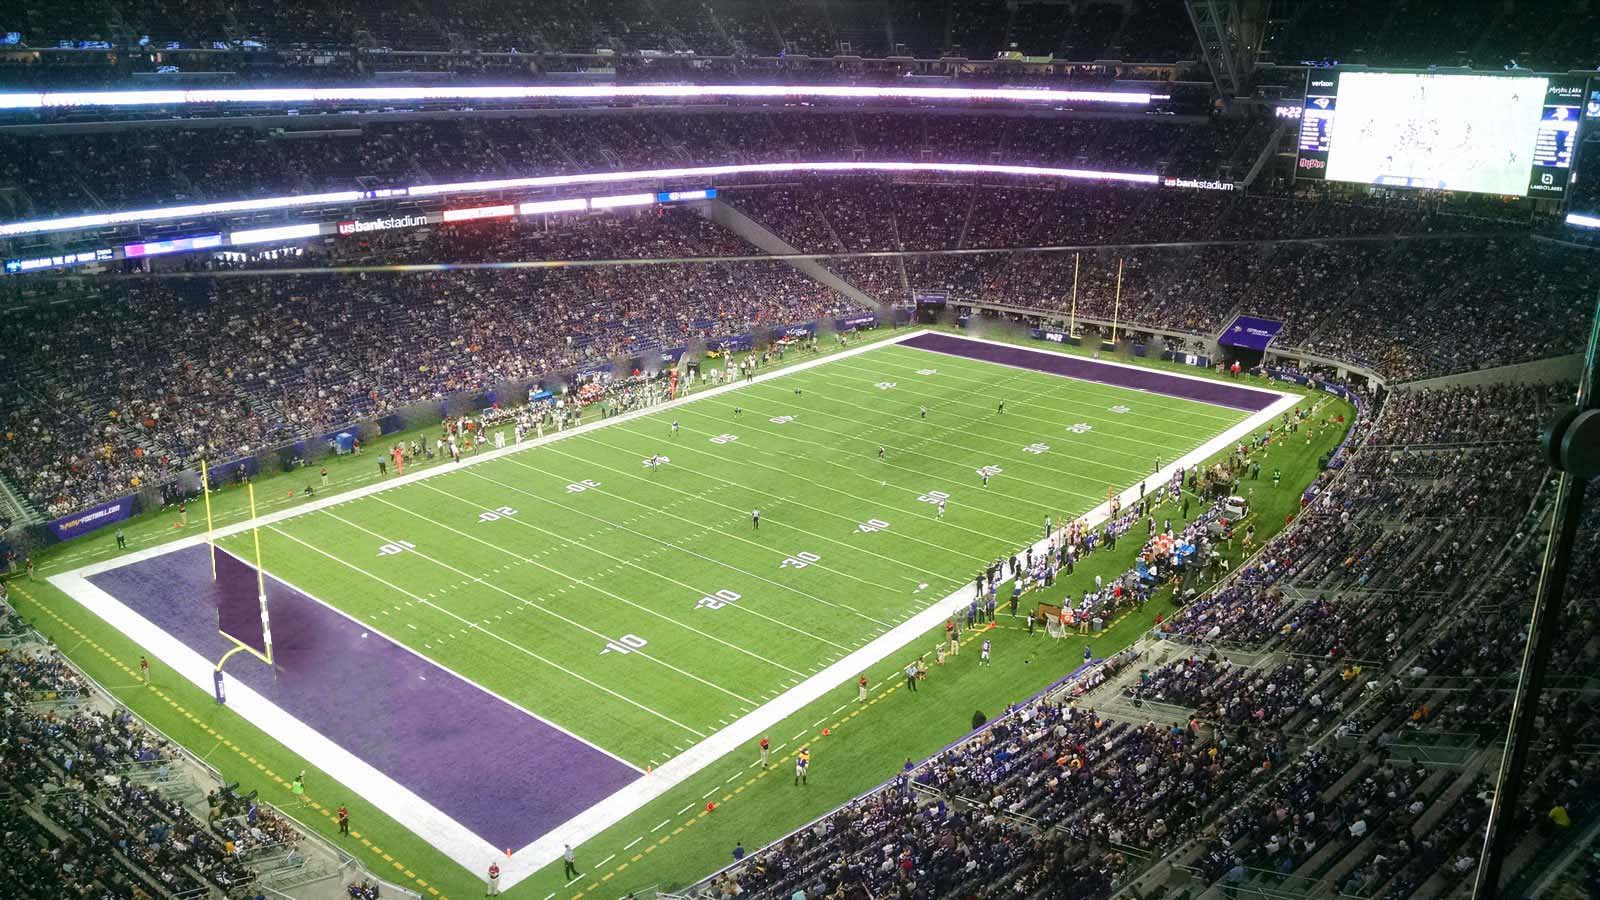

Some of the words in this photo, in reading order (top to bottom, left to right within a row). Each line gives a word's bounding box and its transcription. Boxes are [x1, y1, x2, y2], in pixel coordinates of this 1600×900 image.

[567, 479, 601, 492] 30
[480, 506, 518, 522] 20
[857, 518, 890, 533] 40
[378, 540, 416, 556] 10
[782, 551, 821, 568] 30
[697, 589, 741, 609] 20
[604, 633, 648, 654] 10
